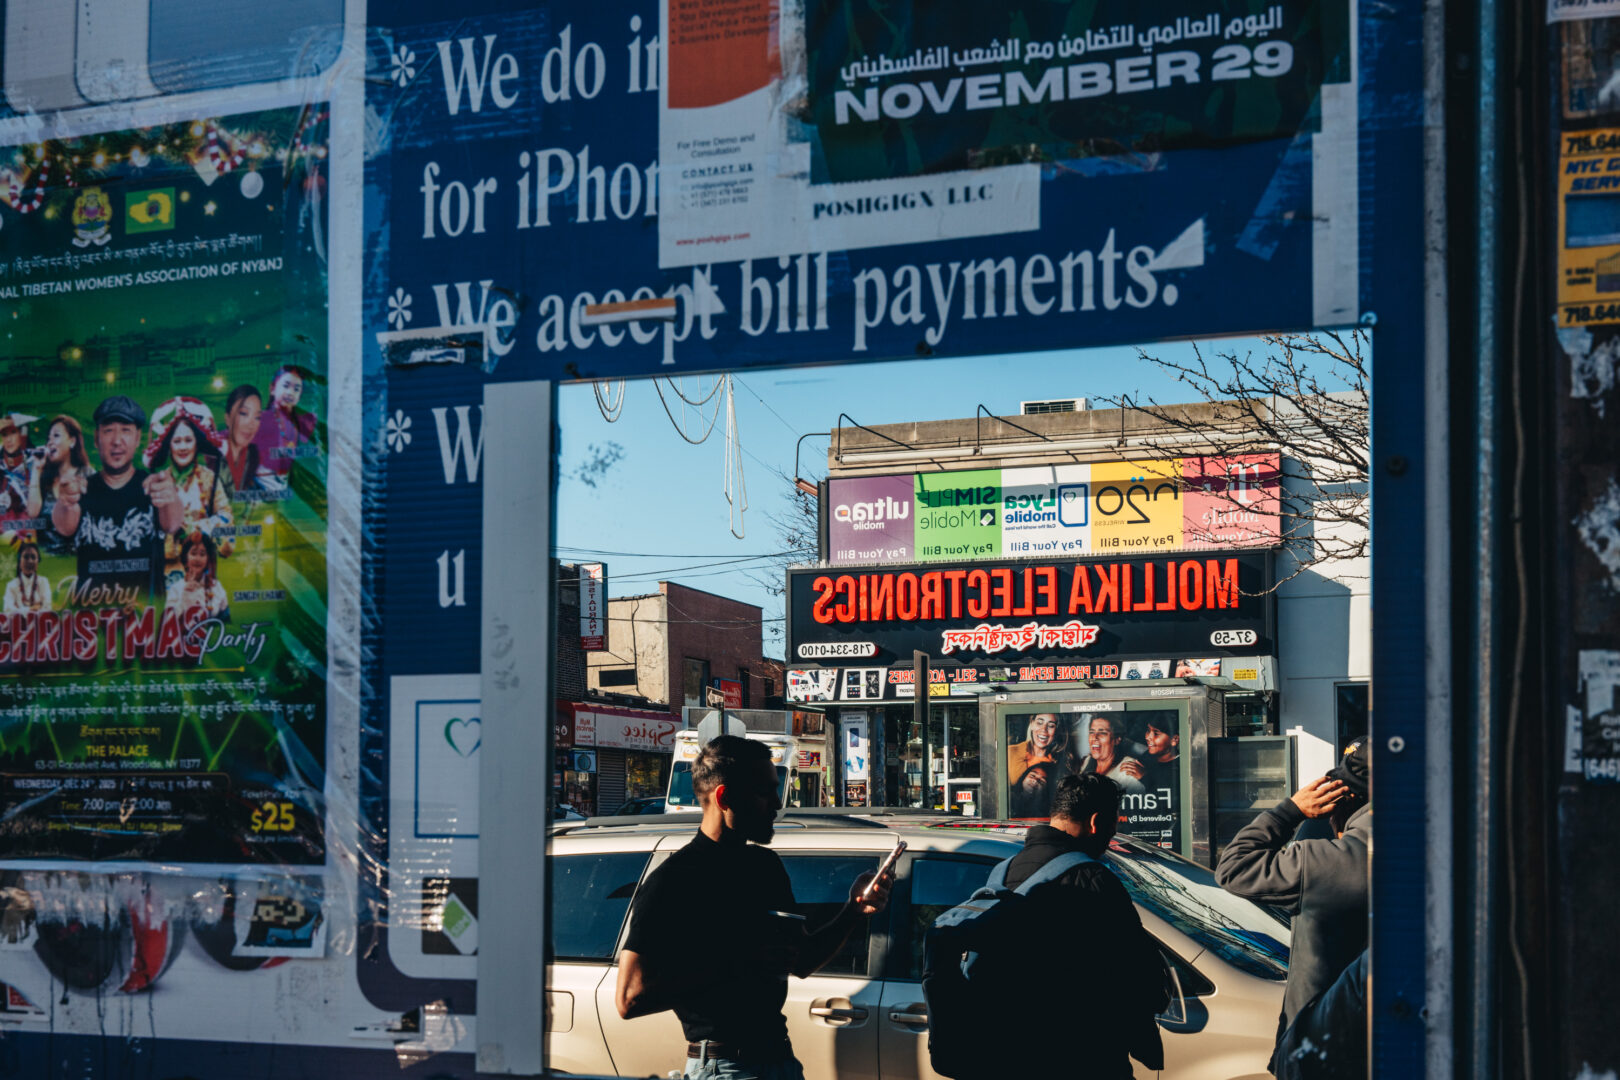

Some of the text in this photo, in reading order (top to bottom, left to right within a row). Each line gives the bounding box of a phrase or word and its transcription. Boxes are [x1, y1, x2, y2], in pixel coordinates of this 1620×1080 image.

[841, 6, 1283, 87] اليوم العالمي للتضامن مع الشعب الفلسطيني
[436, 34, 519, 116] We
[541, 23, 606, 104] do
[834, 40, 1294, 126] NOVEMBER 29
[682, 164, 734, 179] CONTACT
[1565, 159, 1603, 175] NYC
[420, 161, 498, 239] for
[22, 280, 72, 297] TIBETAN
[75, 273, 133, 292] WOMEN'S
[135, 264, 218, 285] ASSOCIATION
[220, 261, 239, 276] OF
[241, 256, 284, 274] NY&NJ
[432, 227, 1179, 365] We accept bill payments.
[55, 575, 140, 614] Merry
[187, 617, 274, 665] Party
[58, 760, 99, 770] Roosevelt
[164, 759, 177, 769] NY
[179, 758, 201, 769] 11377
[86, 744, 149, 757] THE PALACE
[83, 798, 104, 810] 7:00
[250, 800, 296, 834] $25
